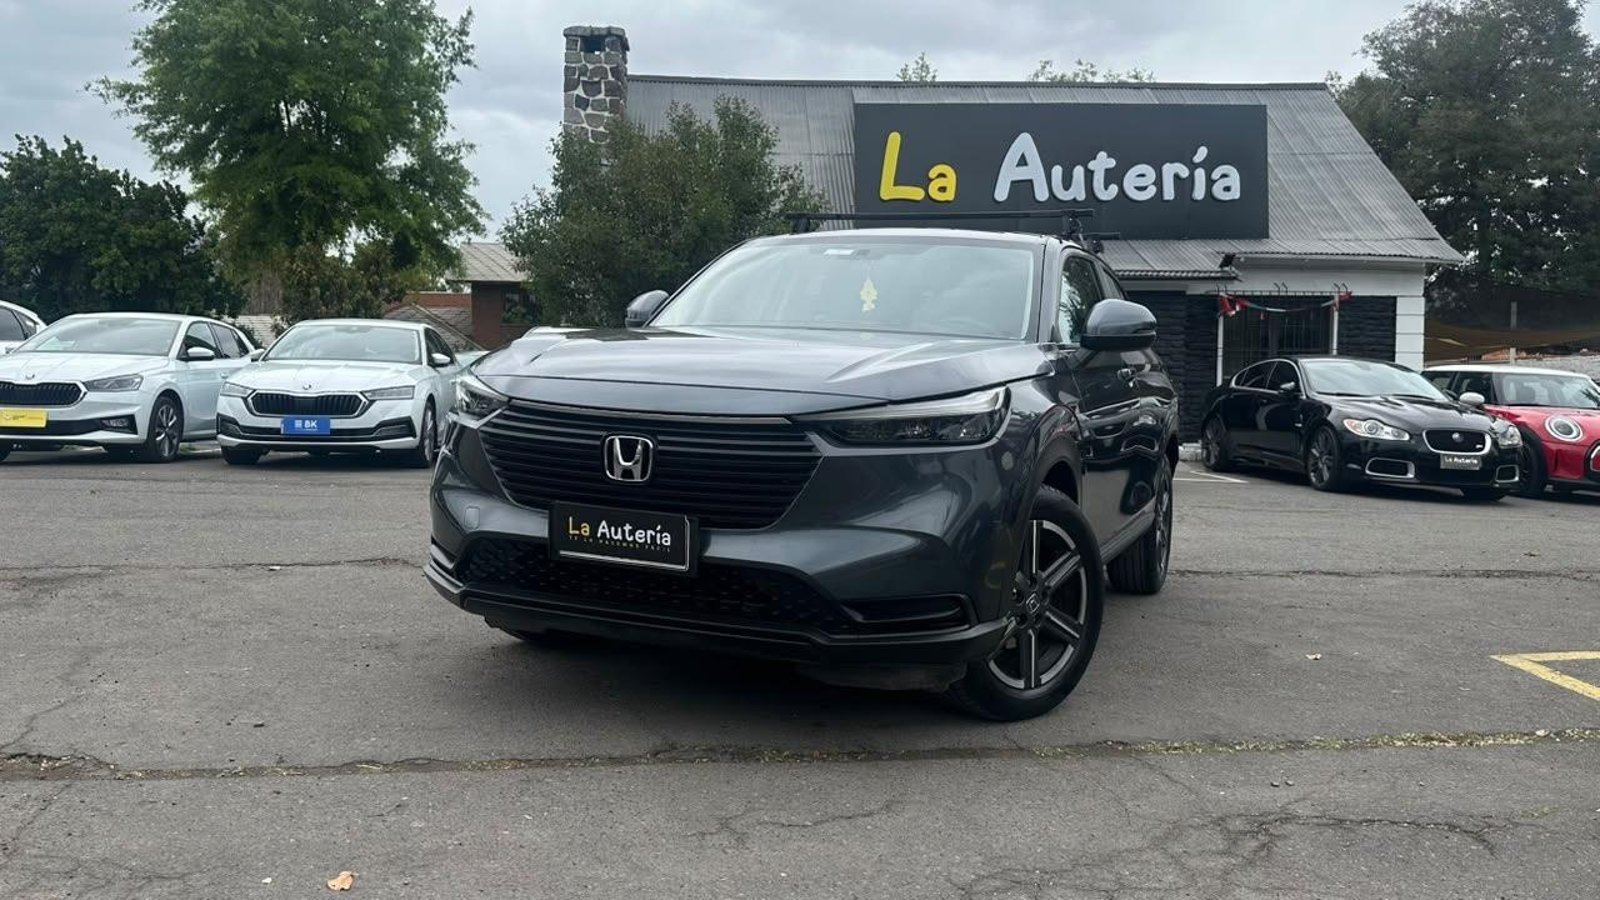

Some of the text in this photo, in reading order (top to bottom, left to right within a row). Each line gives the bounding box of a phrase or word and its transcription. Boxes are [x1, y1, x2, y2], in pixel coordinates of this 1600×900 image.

[879, 130, 1242, 203] La Autería
[568, 515, 590, 536] La
[597, 519, 671, 546] Autería
